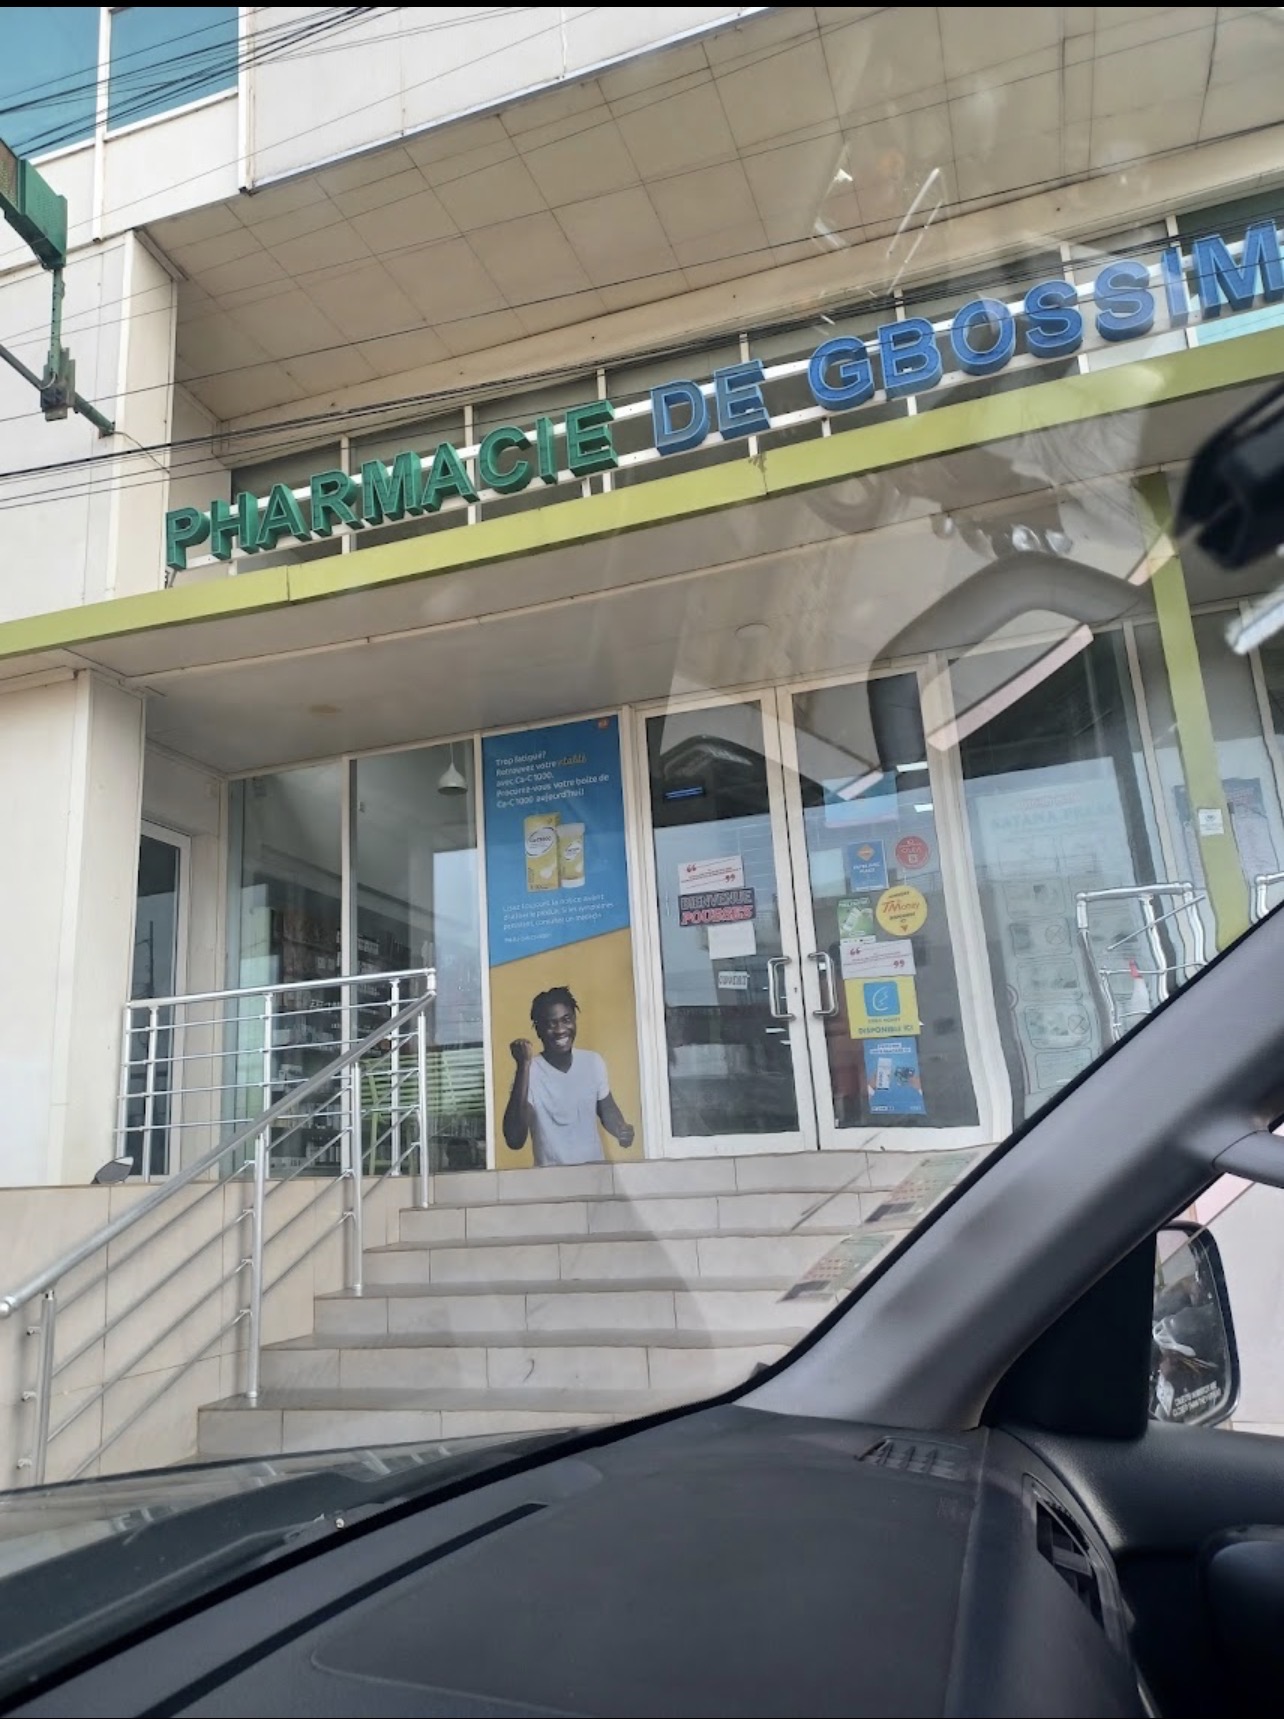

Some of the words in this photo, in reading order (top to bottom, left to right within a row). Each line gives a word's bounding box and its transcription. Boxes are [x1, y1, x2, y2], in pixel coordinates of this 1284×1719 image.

[165, 400, 618, 571] PHARMACIE
[650, 359, 771, 456] DE
[807, 219, 1284, 411] GBOSSIM
[598, 774, 610, 782] de
[681, 890, 752, 910] BIENVENUE
